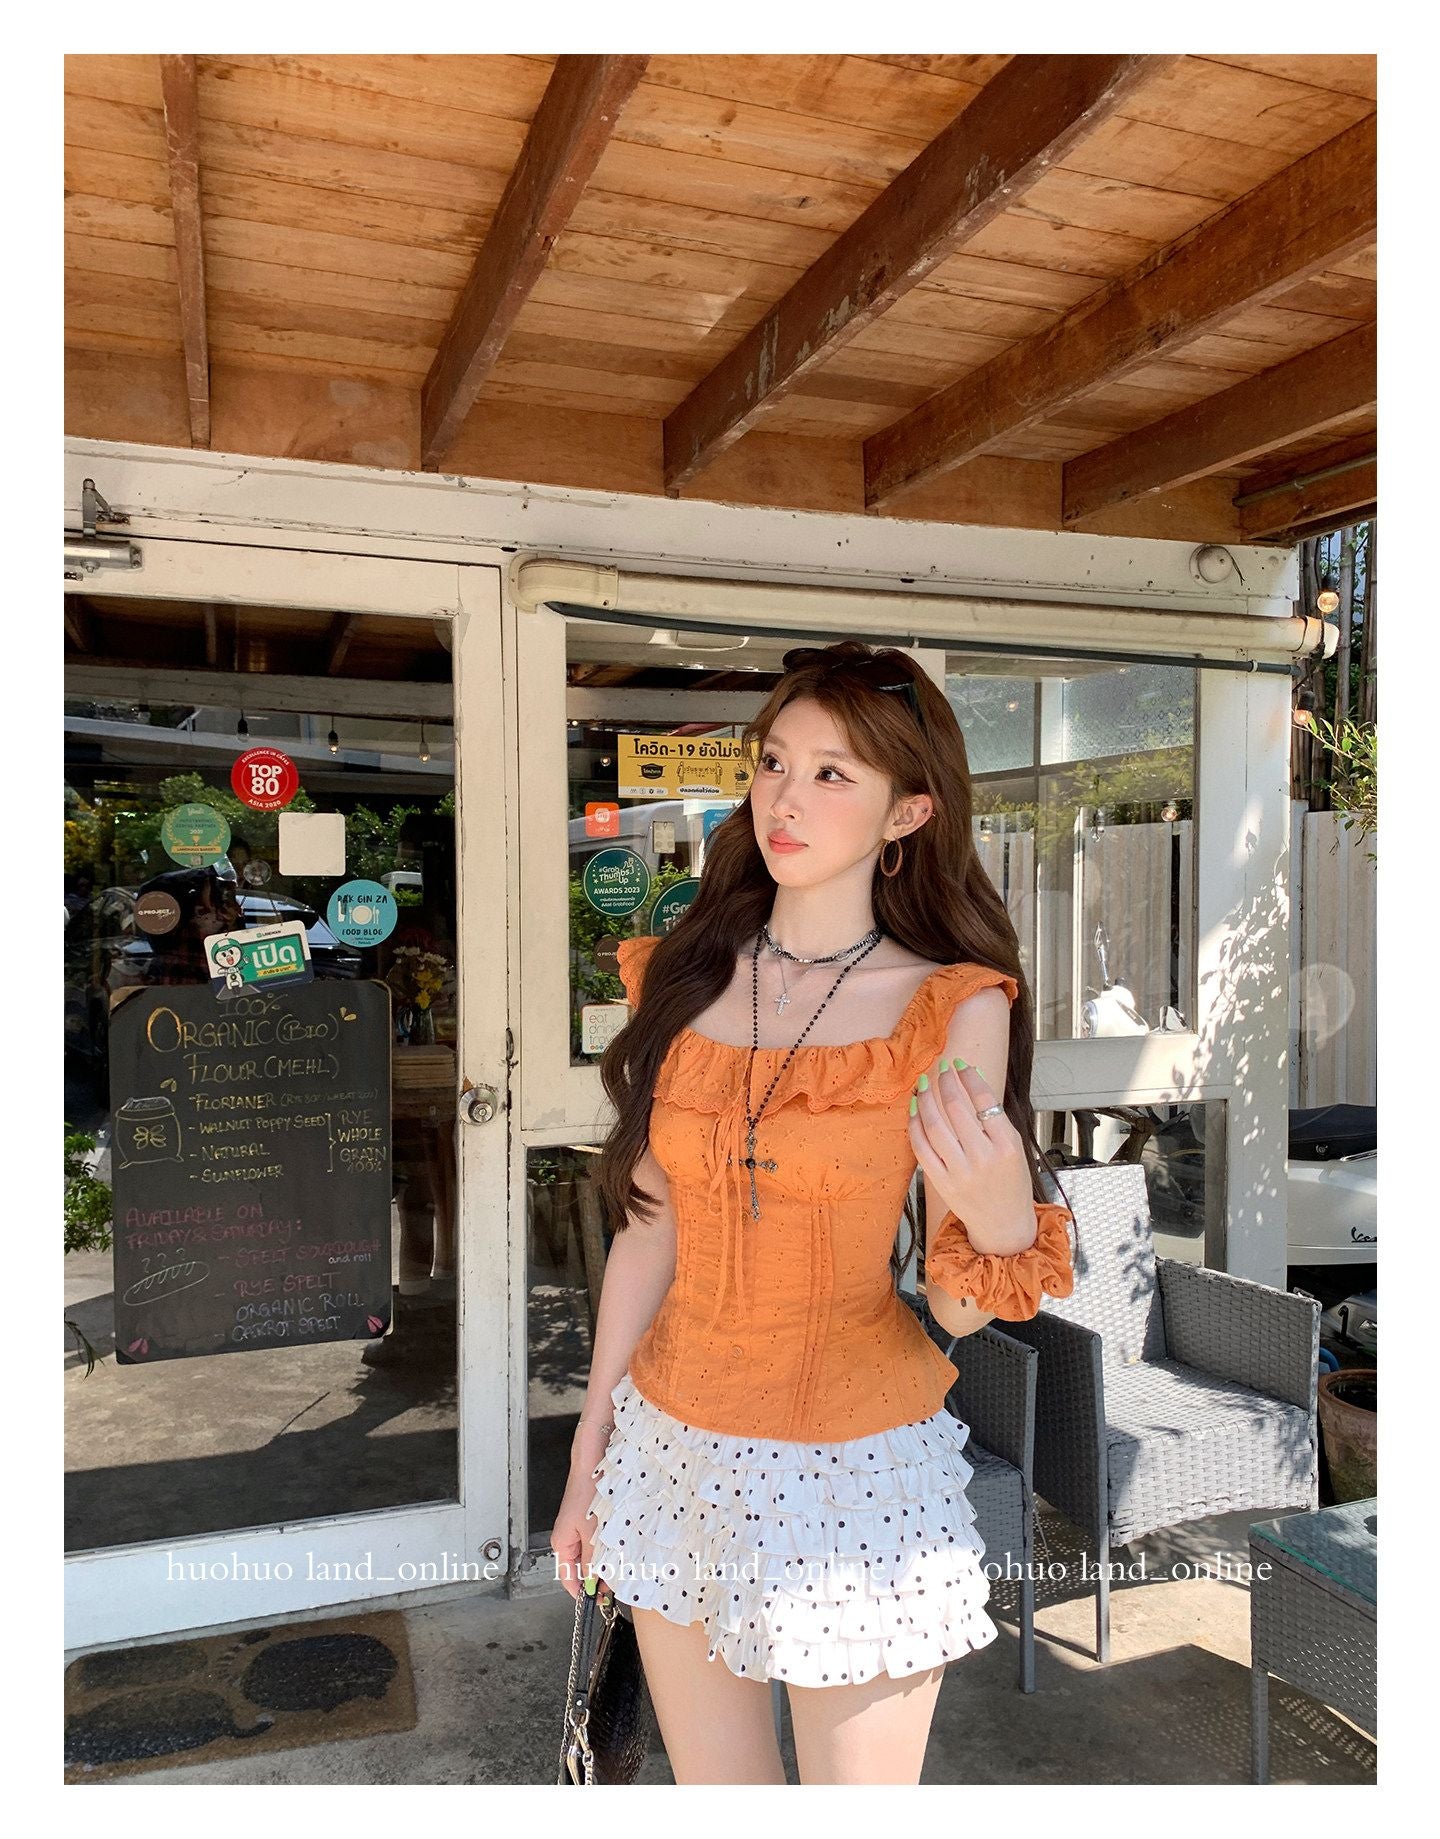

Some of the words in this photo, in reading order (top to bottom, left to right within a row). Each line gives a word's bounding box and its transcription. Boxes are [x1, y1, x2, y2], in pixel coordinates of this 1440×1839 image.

[248, 763, 283, 778] TOP
[251, 777, 280, 796] 80
[248, 798, 264, 808] ASIA
[264, 800, 282, 809] 2020
[599, 867, 631, 882] Thumbs
[618, 876, 629, 885] Up
[593, 886, 623, 895] AWARDS
[624, 886, 641, 894] 2023
[357, 895, 373, 904] GIN
[375, 895, 388, 904] ZA
[251, 942, 298, 969] เปิด
[216, 992, 288, 1018] 100%
[589, 1013, 608, 1024] eat
[200, 1118, 252, 1135] WALNUT
[255, 1115, 293, 1133] POPPY
[293, 1115, 326, 1129] SEED
[337, 1109, 374, 1125] RYE
[337, 1127, 383, 1143] WHOLE
[201, 1143, 271, 1161] NATURAL
[339, 1145, 387, 1163] GRAIN
[201, 1164, 284, 1184] SUNFLOWER
[126, 1206, 225, 1229] AVAILABLE
[236, 1202, 264, 1219] ON
[328, 1256, 351, 1264] and
[353, 1252, 372, 1263] roll
[233, 1279, 276, 1298] RYE
[282, 1271, 342, 1293] SPELT
[235, 1296, 314, 1322] ORGANIC
